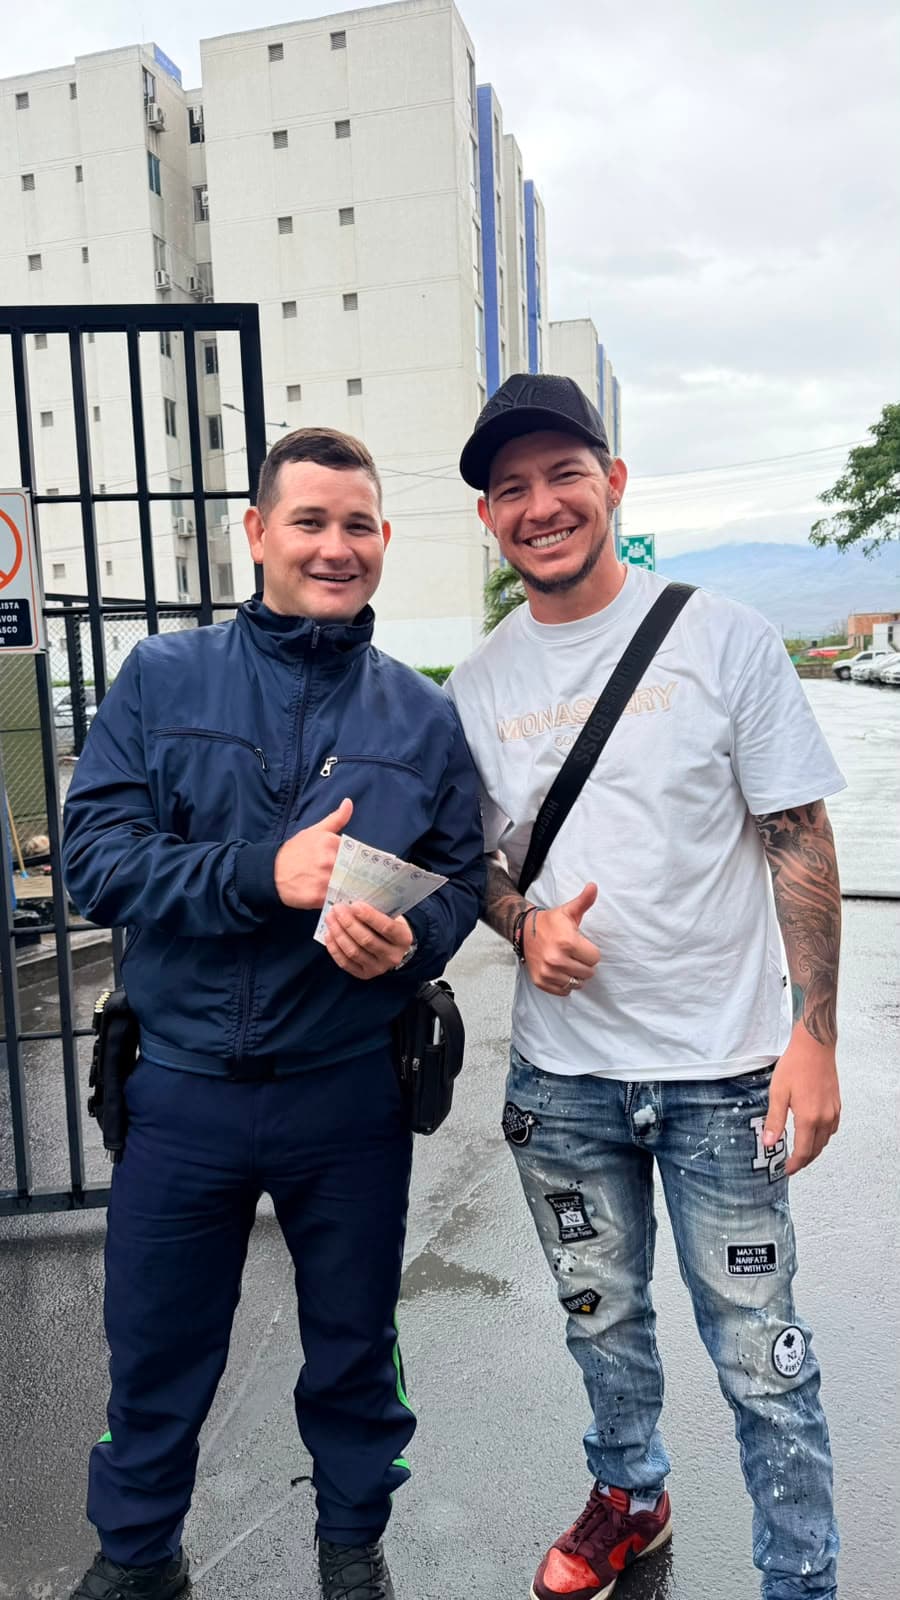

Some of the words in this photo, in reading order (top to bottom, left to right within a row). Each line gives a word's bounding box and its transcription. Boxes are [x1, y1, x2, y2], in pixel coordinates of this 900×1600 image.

[736, 1248, 753, 1256] MAX
[754, 1247, 768, 1255] THE
[743, 1264, 761, 1273] WITH
[761, 1263, 777, 1272] YOU
